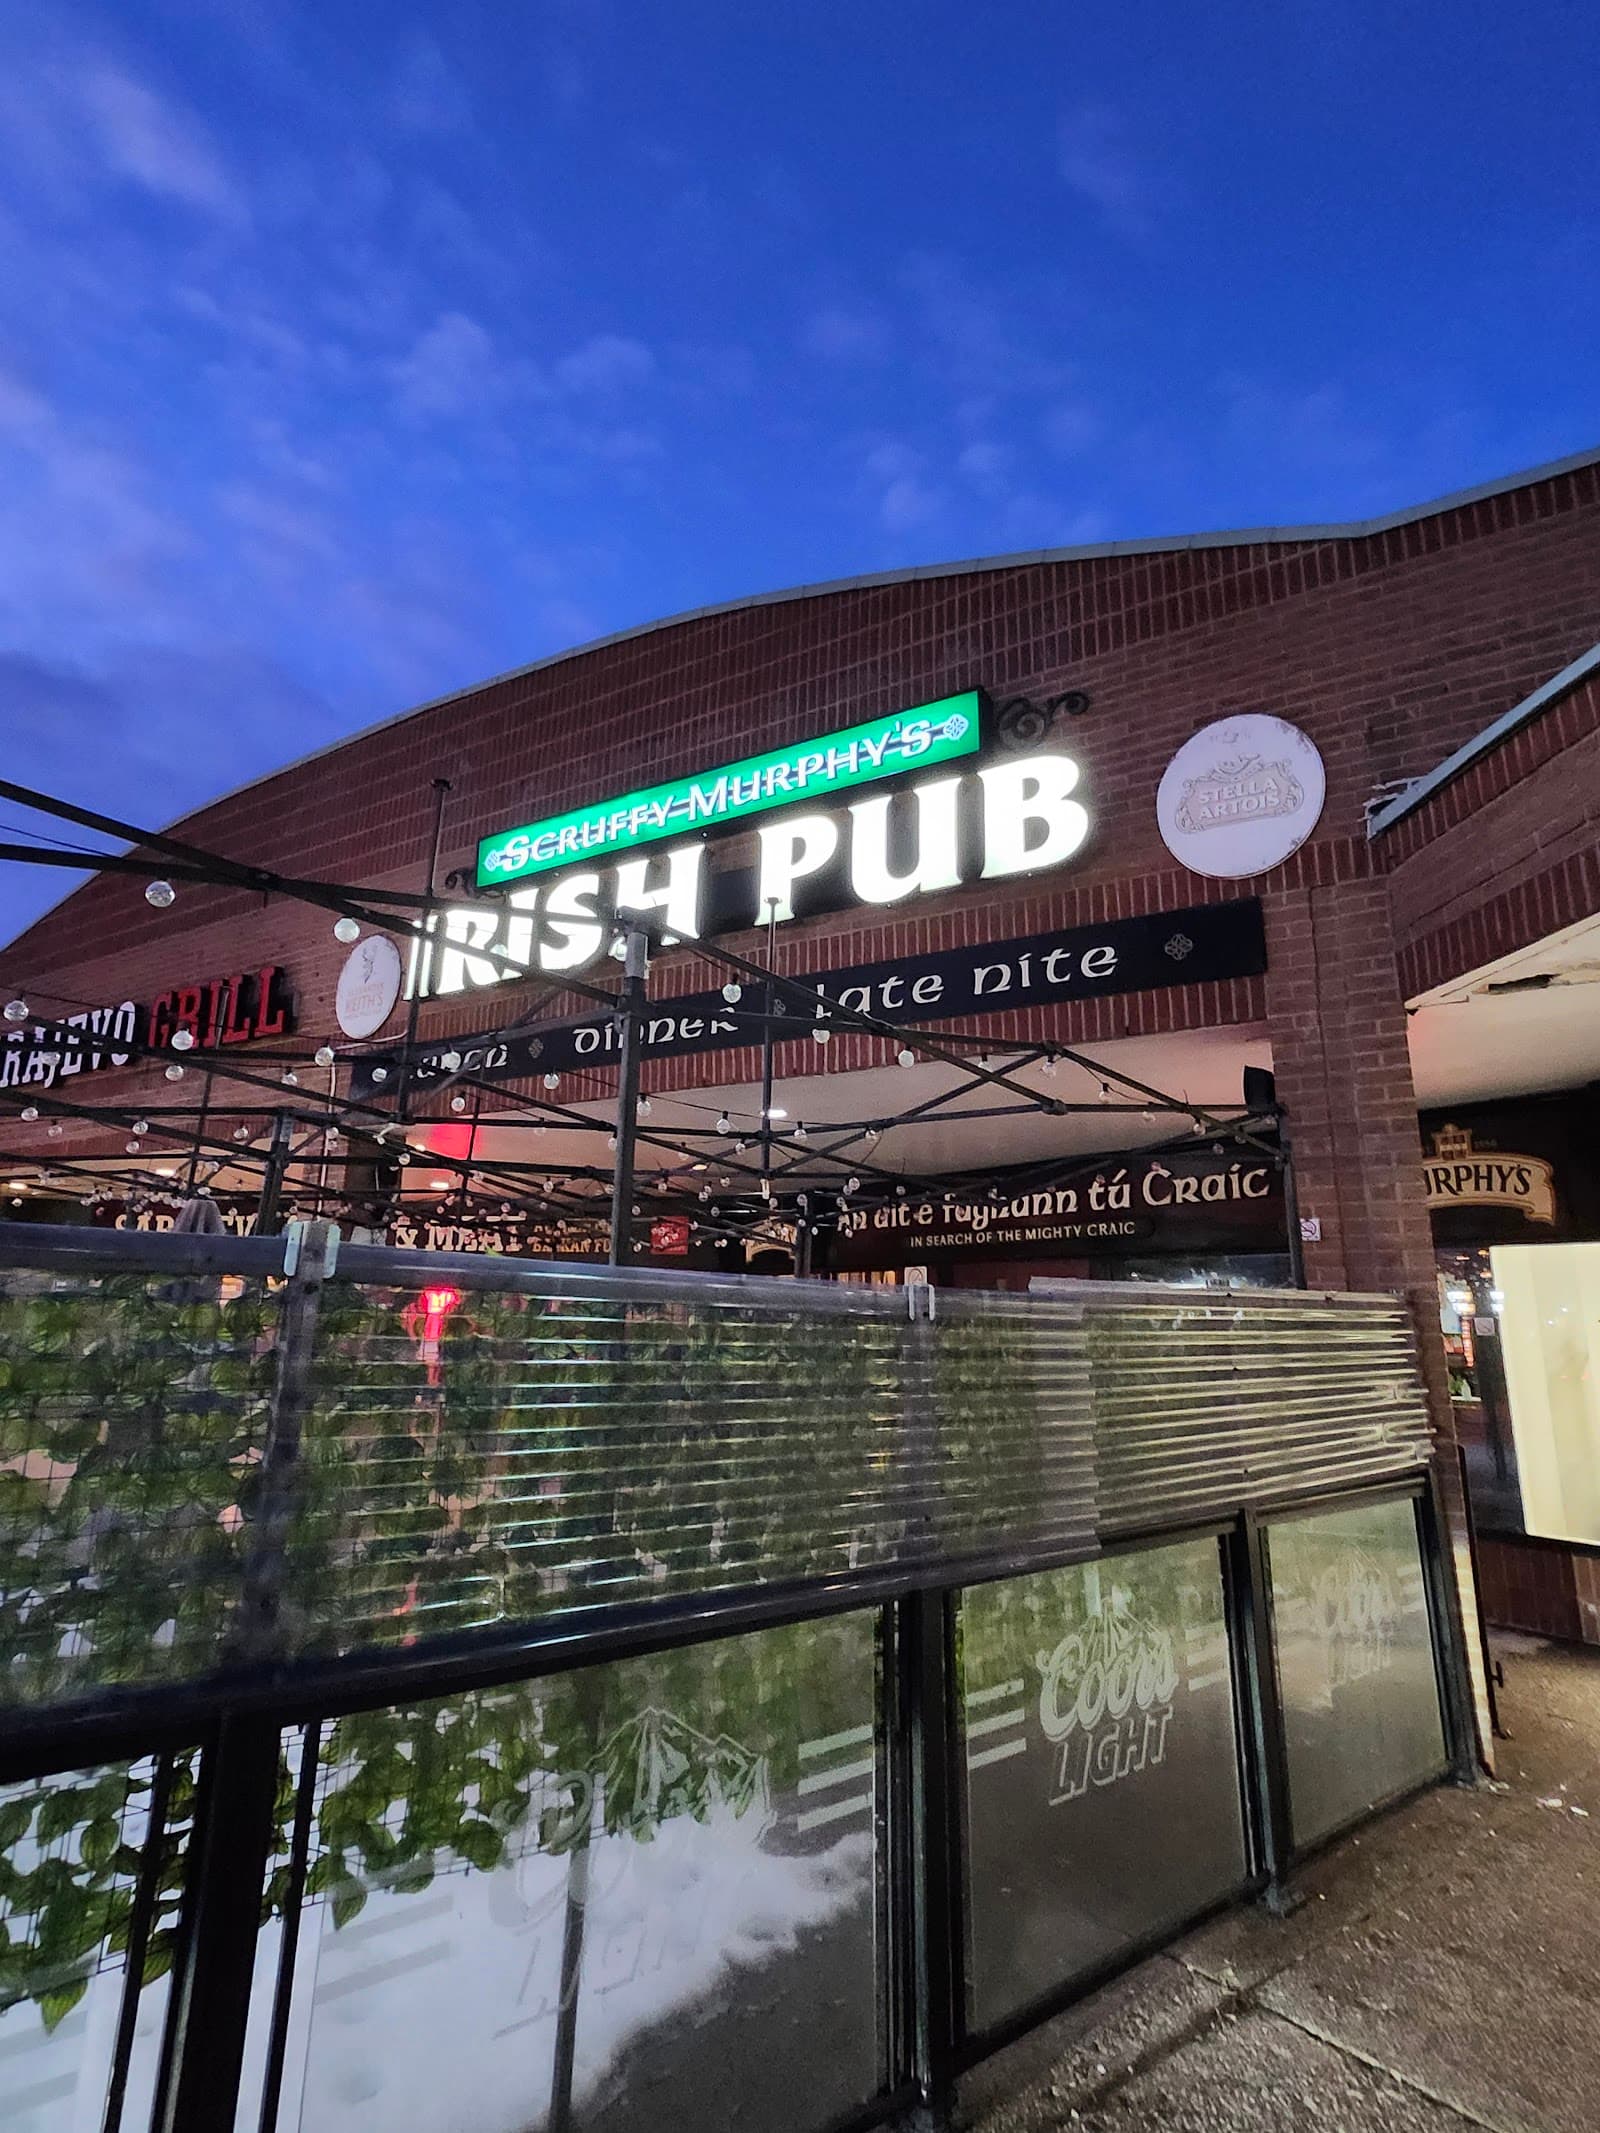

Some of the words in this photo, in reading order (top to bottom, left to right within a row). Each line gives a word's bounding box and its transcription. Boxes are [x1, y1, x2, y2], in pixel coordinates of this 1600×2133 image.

[504, 793, 676, 873] SCRUFFY
[687, 721, 932, 818] MURPHY'S
[1198, 777, 1279, 804] STELLA
[1198, 794, 1281, 821] ARTOIS
[754, 754, 1090, 927] PUB
[974, 946, 1119, 995] nite
[148, 966, 285, 1048] GRILL
[1088, 1169, 1132, 1211] tú
[1424, 1164, 1531, 1196] RPHY'S
[910, 1235, 922, 1248] IN
[926, 1233, 972, 1247] SEARCH
[976, 1231, 992, 1243] OF
[997, 1229, 1021, 1241] THE
[1025, 1225, 1081, 1240] MIGHTY
[1087, 1221, 1135, 1237] CRAIC
[1035, 1632, 1180, 1743] Coors
